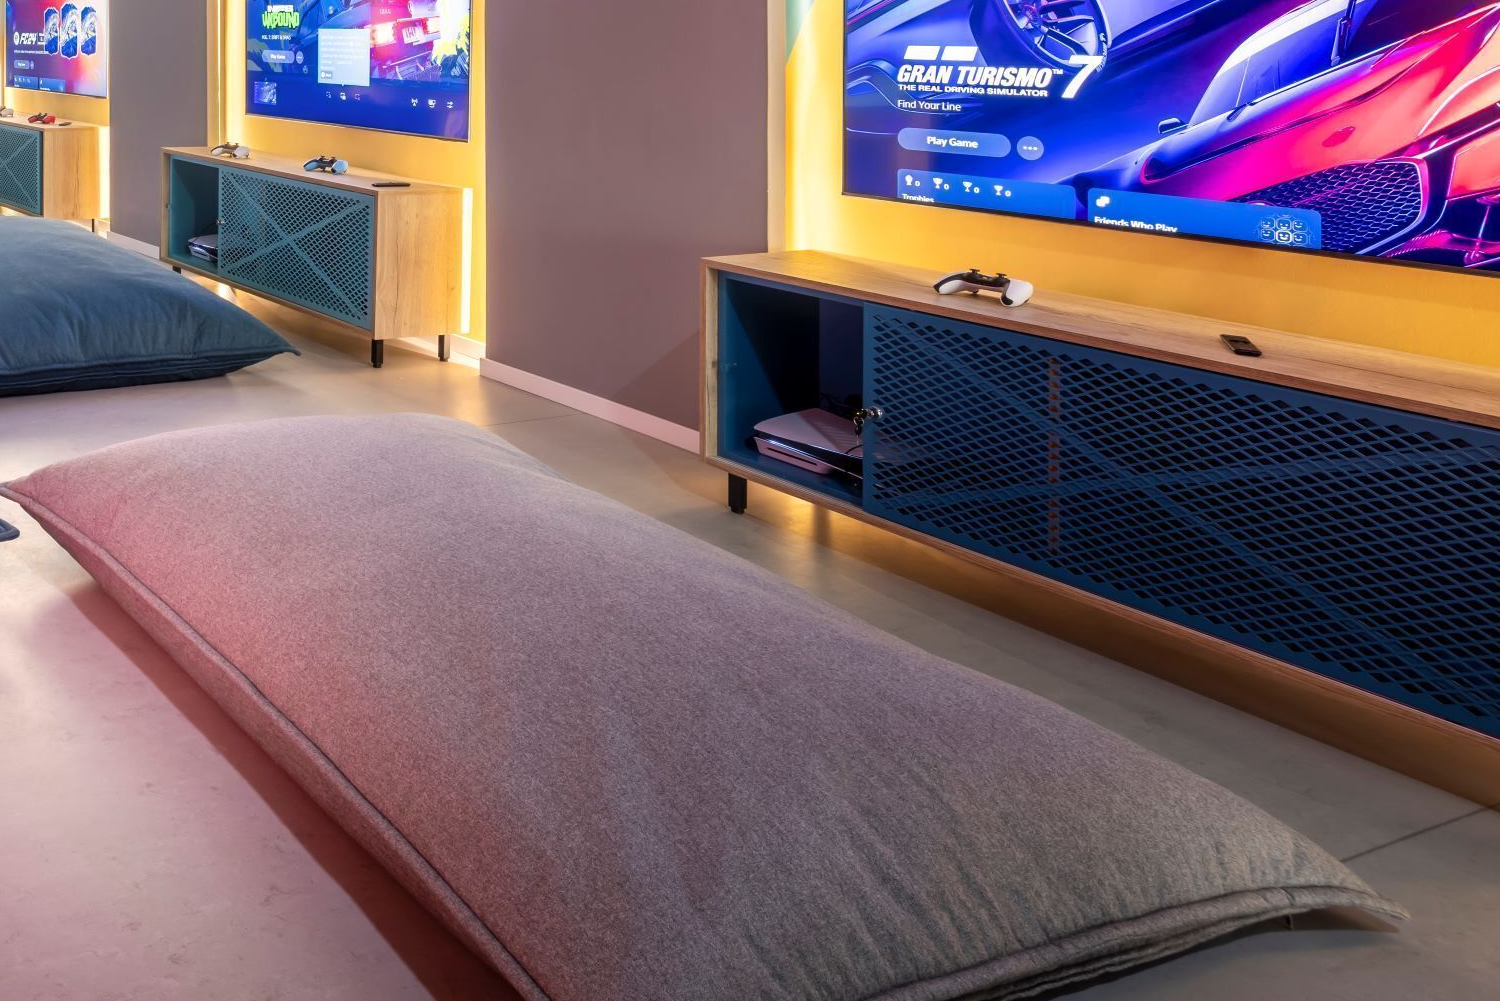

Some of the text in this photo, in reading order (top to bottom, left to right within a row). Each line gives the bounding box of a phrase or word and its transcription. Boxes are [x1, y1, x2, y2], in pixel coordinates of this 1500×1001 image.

[897, 64, 953, 84] GRAN
[1061, 55, 1104, 99] 7
[918, 85, 943, 93] REAL
[944, 87, 985, 95] DRIVING
[986, 88, 1048, 97] SIMULATOR
[897, 99, 961, 111] Find Your Line
[926, 136, 979, 149] Play Game
[1094, 216, 1129, 227] Friends
[1130, 220, 1154, 230] Who
